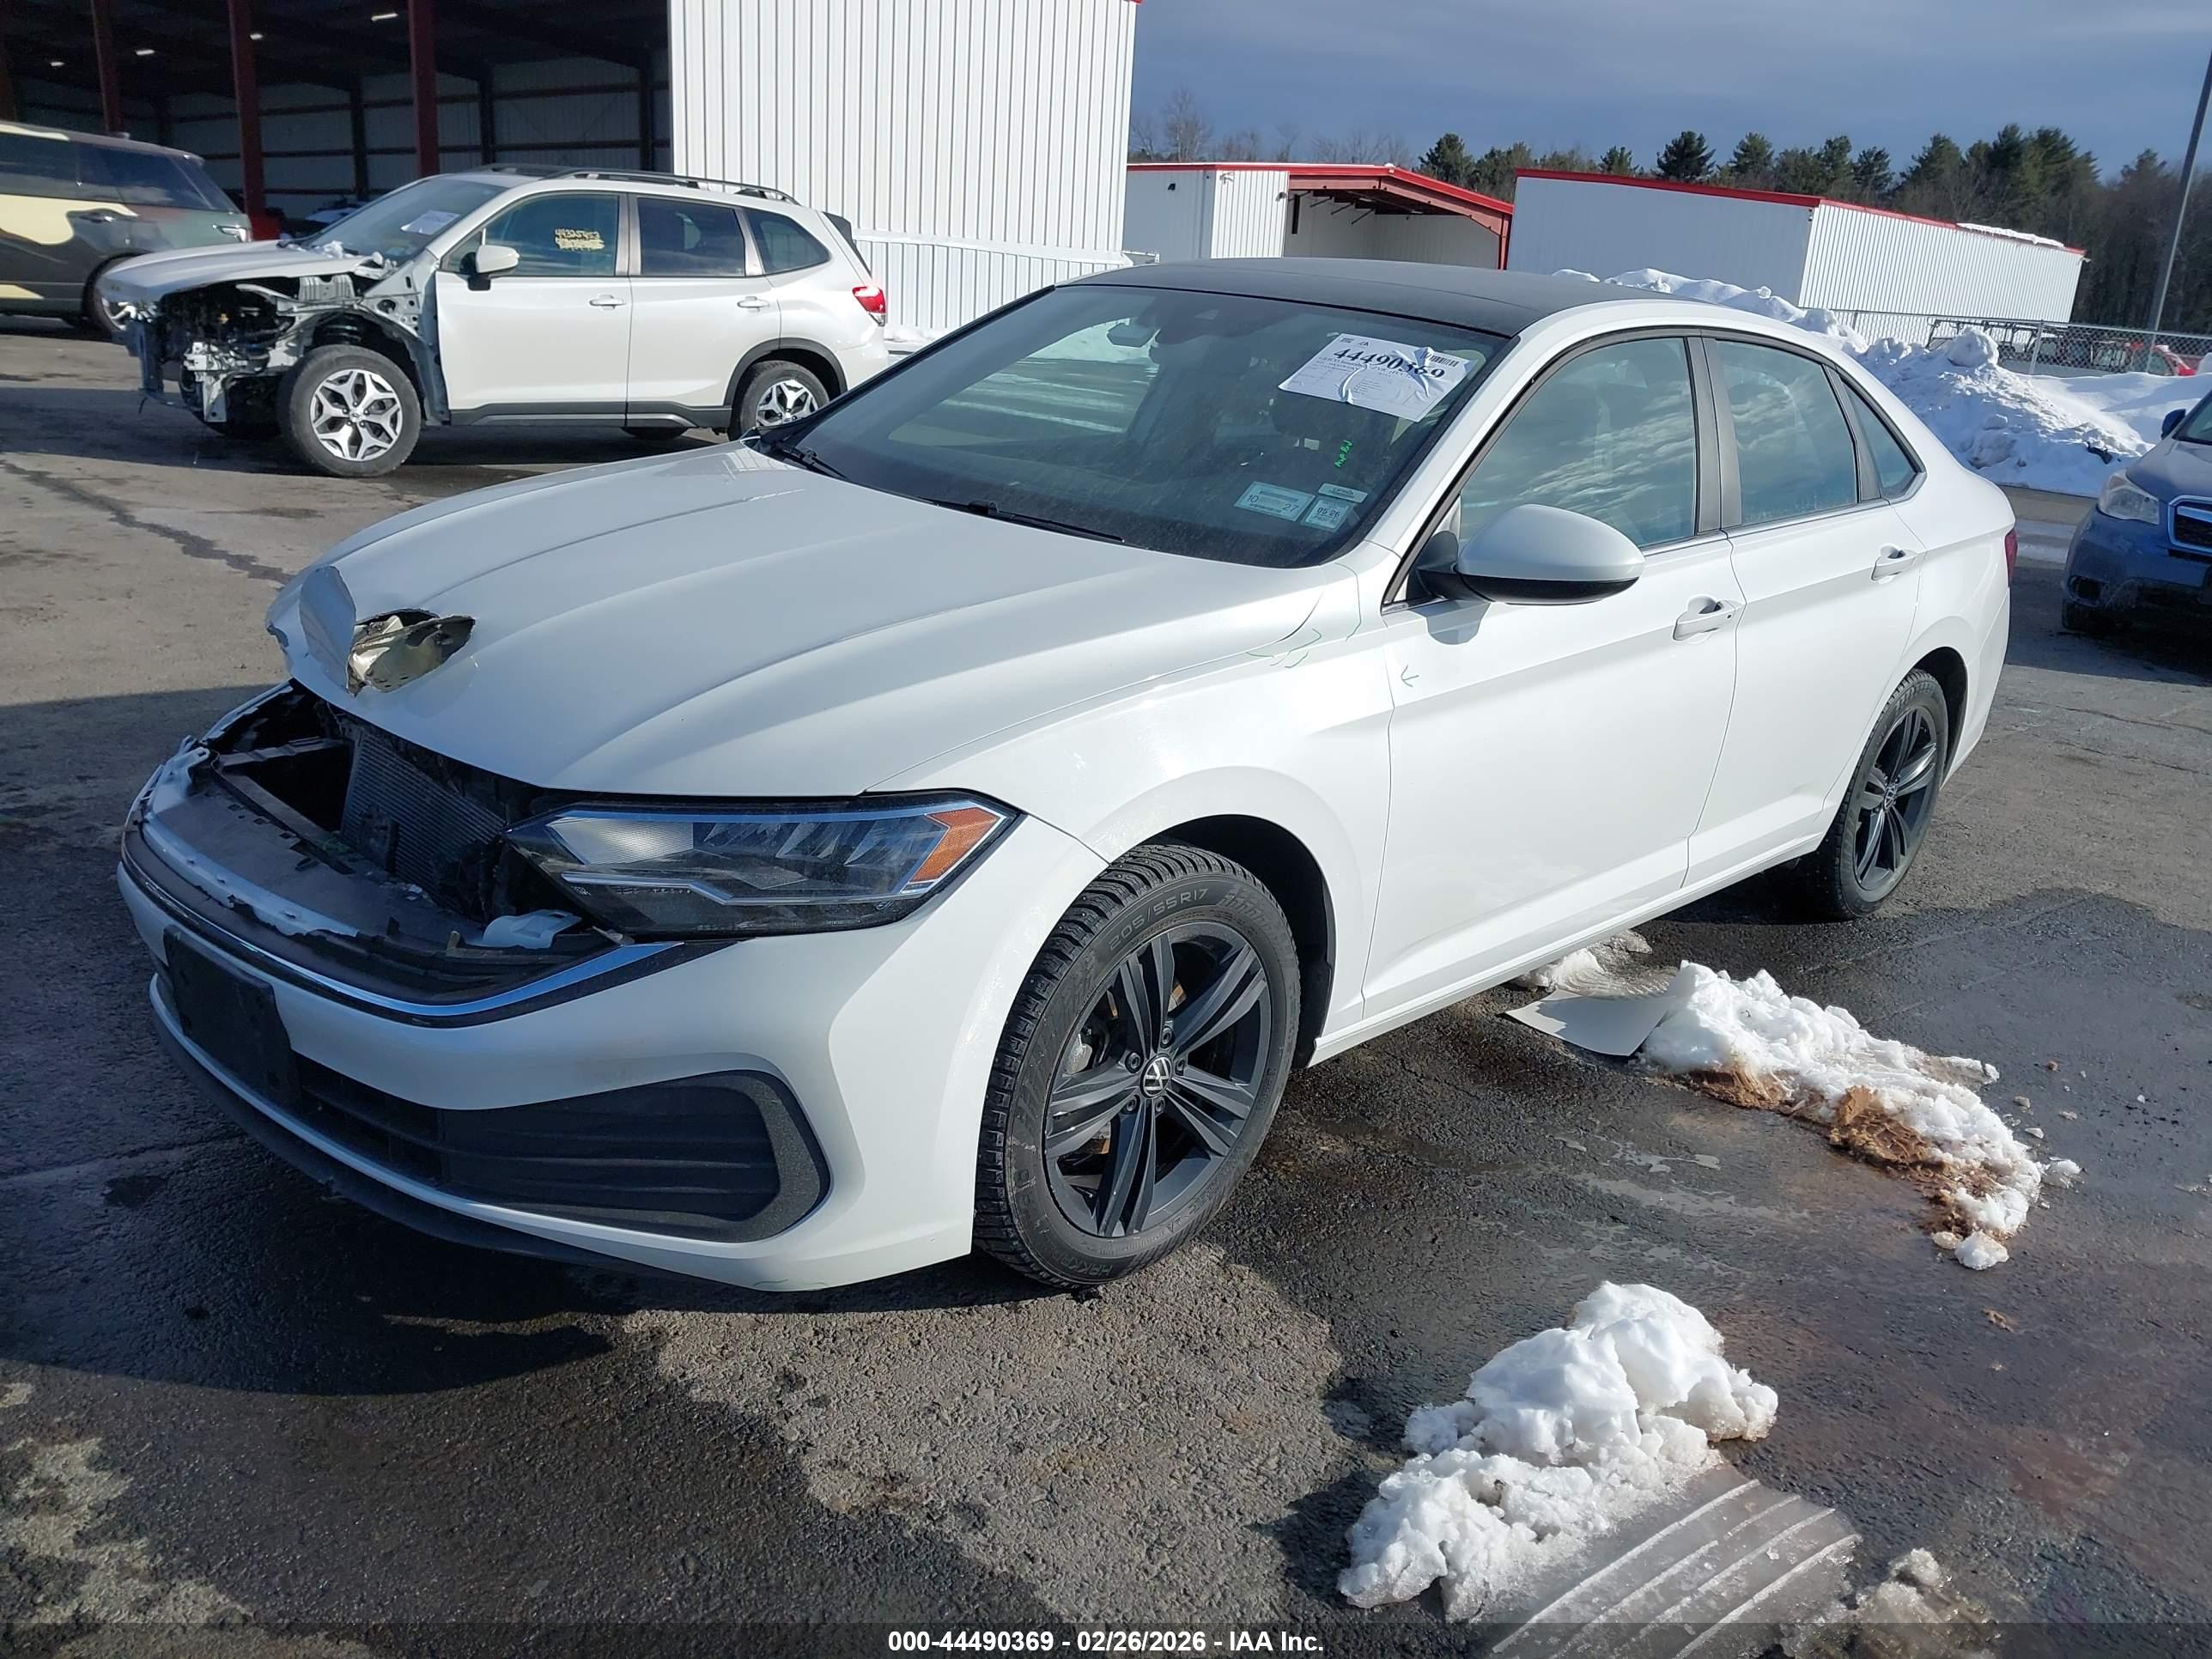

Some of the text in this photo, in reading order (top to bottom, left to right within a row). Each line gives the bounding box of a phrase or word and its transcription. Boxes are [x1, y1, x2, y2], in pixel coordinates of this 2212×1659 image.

[1333, 348, 1446, 379] 44490369
[1248, 495, 1259, 503] 10
[1282, 503, 1299, 512] 27
